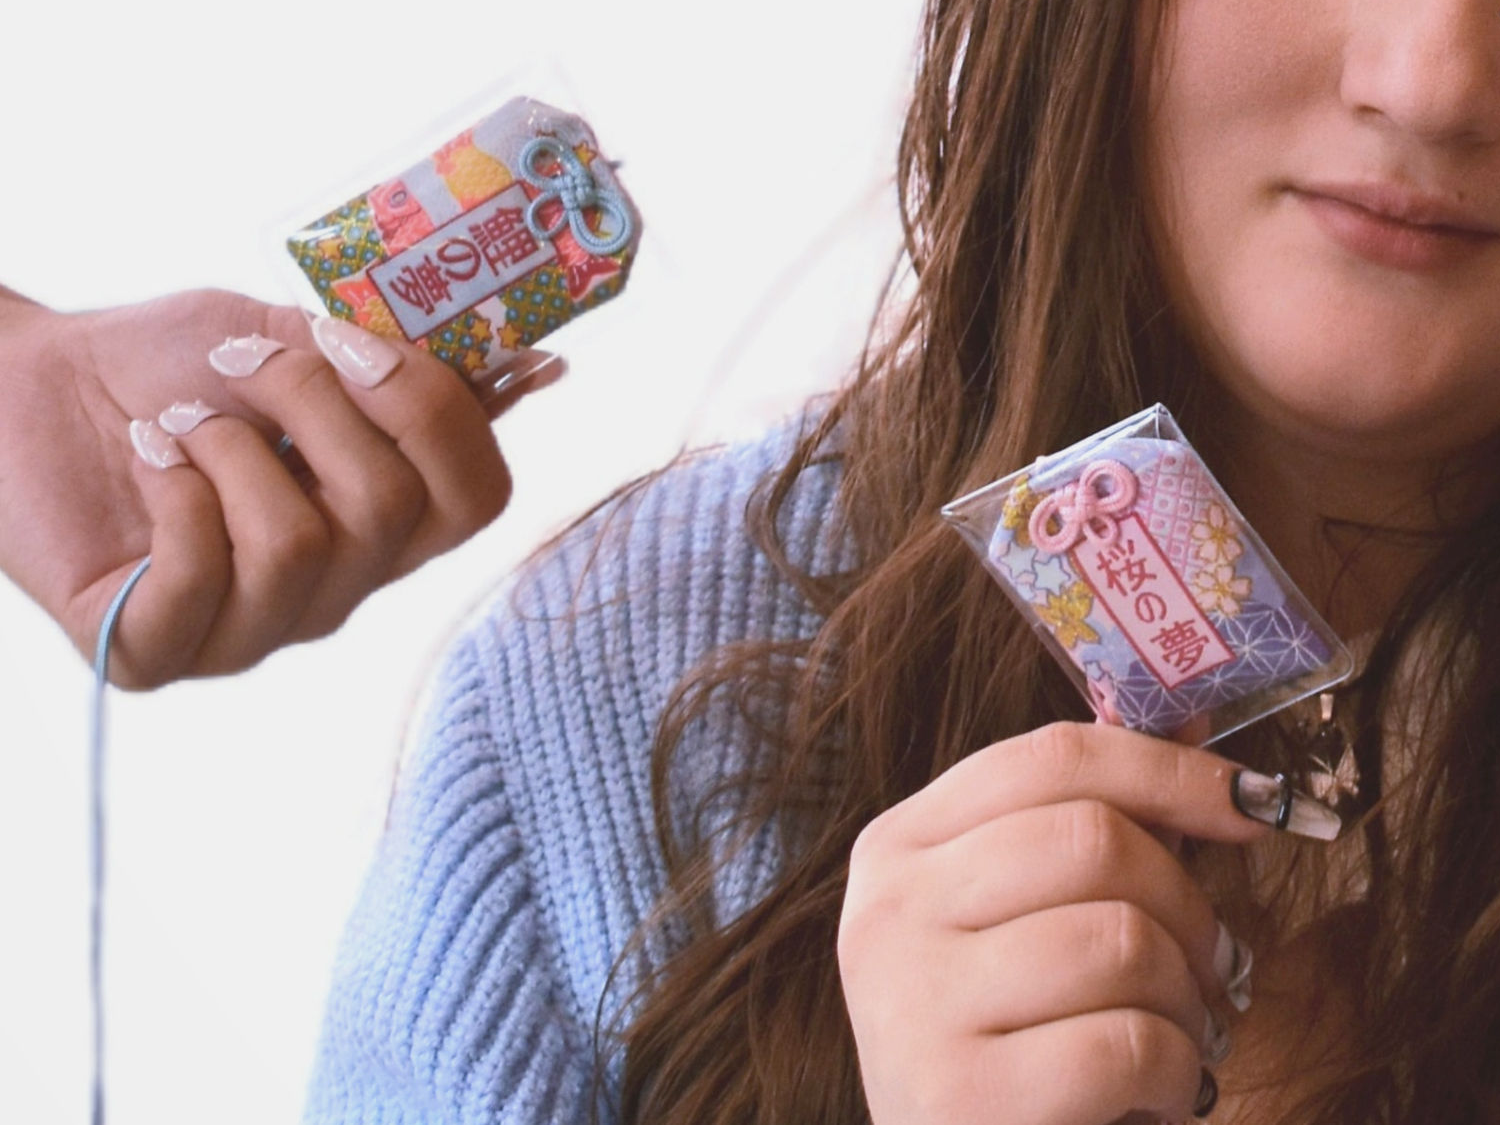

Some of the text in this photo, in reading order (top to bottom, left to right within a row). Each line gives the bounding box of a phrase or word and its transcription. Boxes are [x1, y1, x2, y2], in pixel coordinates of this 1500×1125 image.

[390, 204, 540, 316] 鯉の夢
[1096, 540, 1210, 674] 桜の夢
